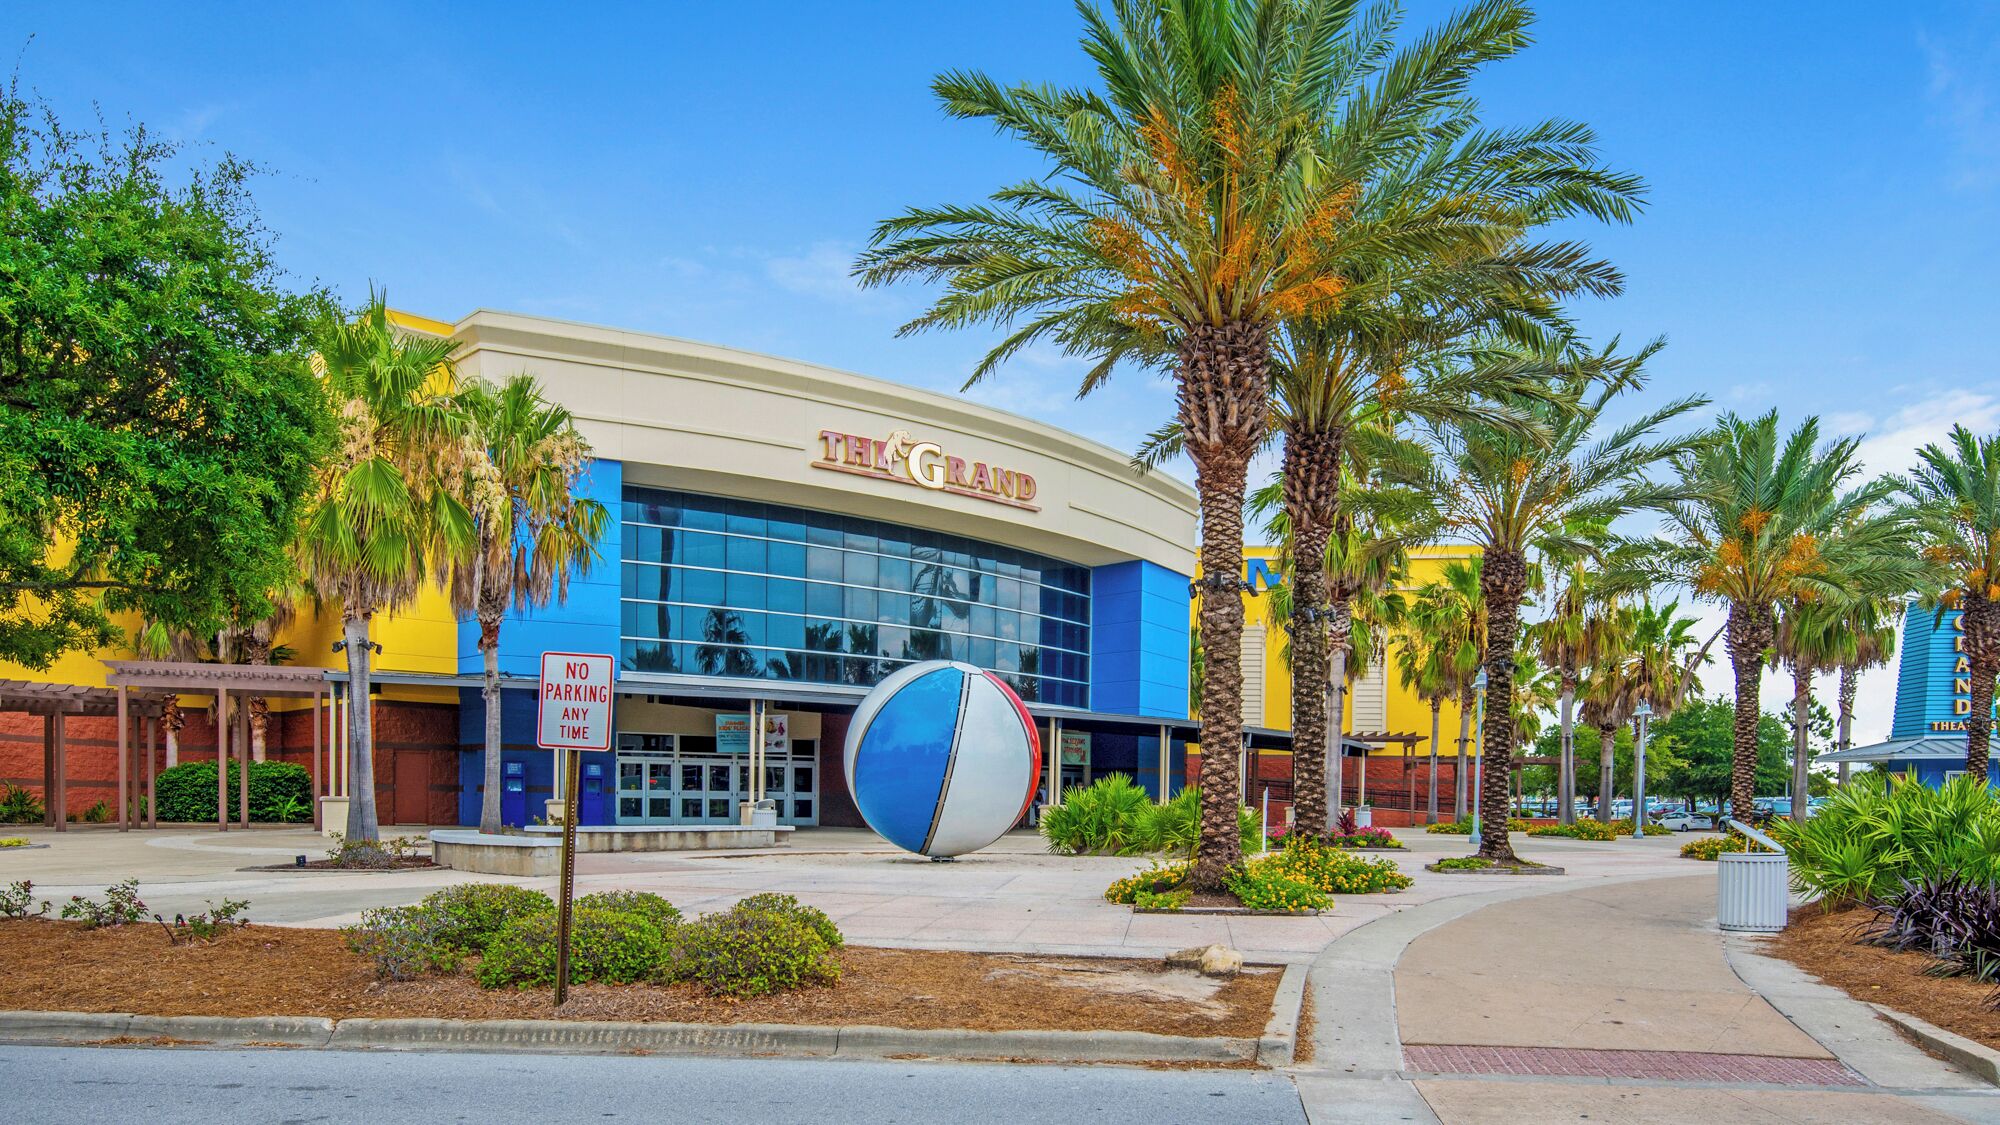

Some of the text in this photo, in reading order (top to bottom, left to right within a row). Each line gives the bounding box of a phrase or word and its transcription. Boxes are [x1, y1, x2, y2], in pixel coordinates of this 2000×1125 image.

[906, 441, 1037, 500] GRAND
[566, 662, 589, 680] NO
[545, 683, 608, 704] PARKING
[562, 707, 589, 721] ANY
[559, 725, 590, 740] TIME
